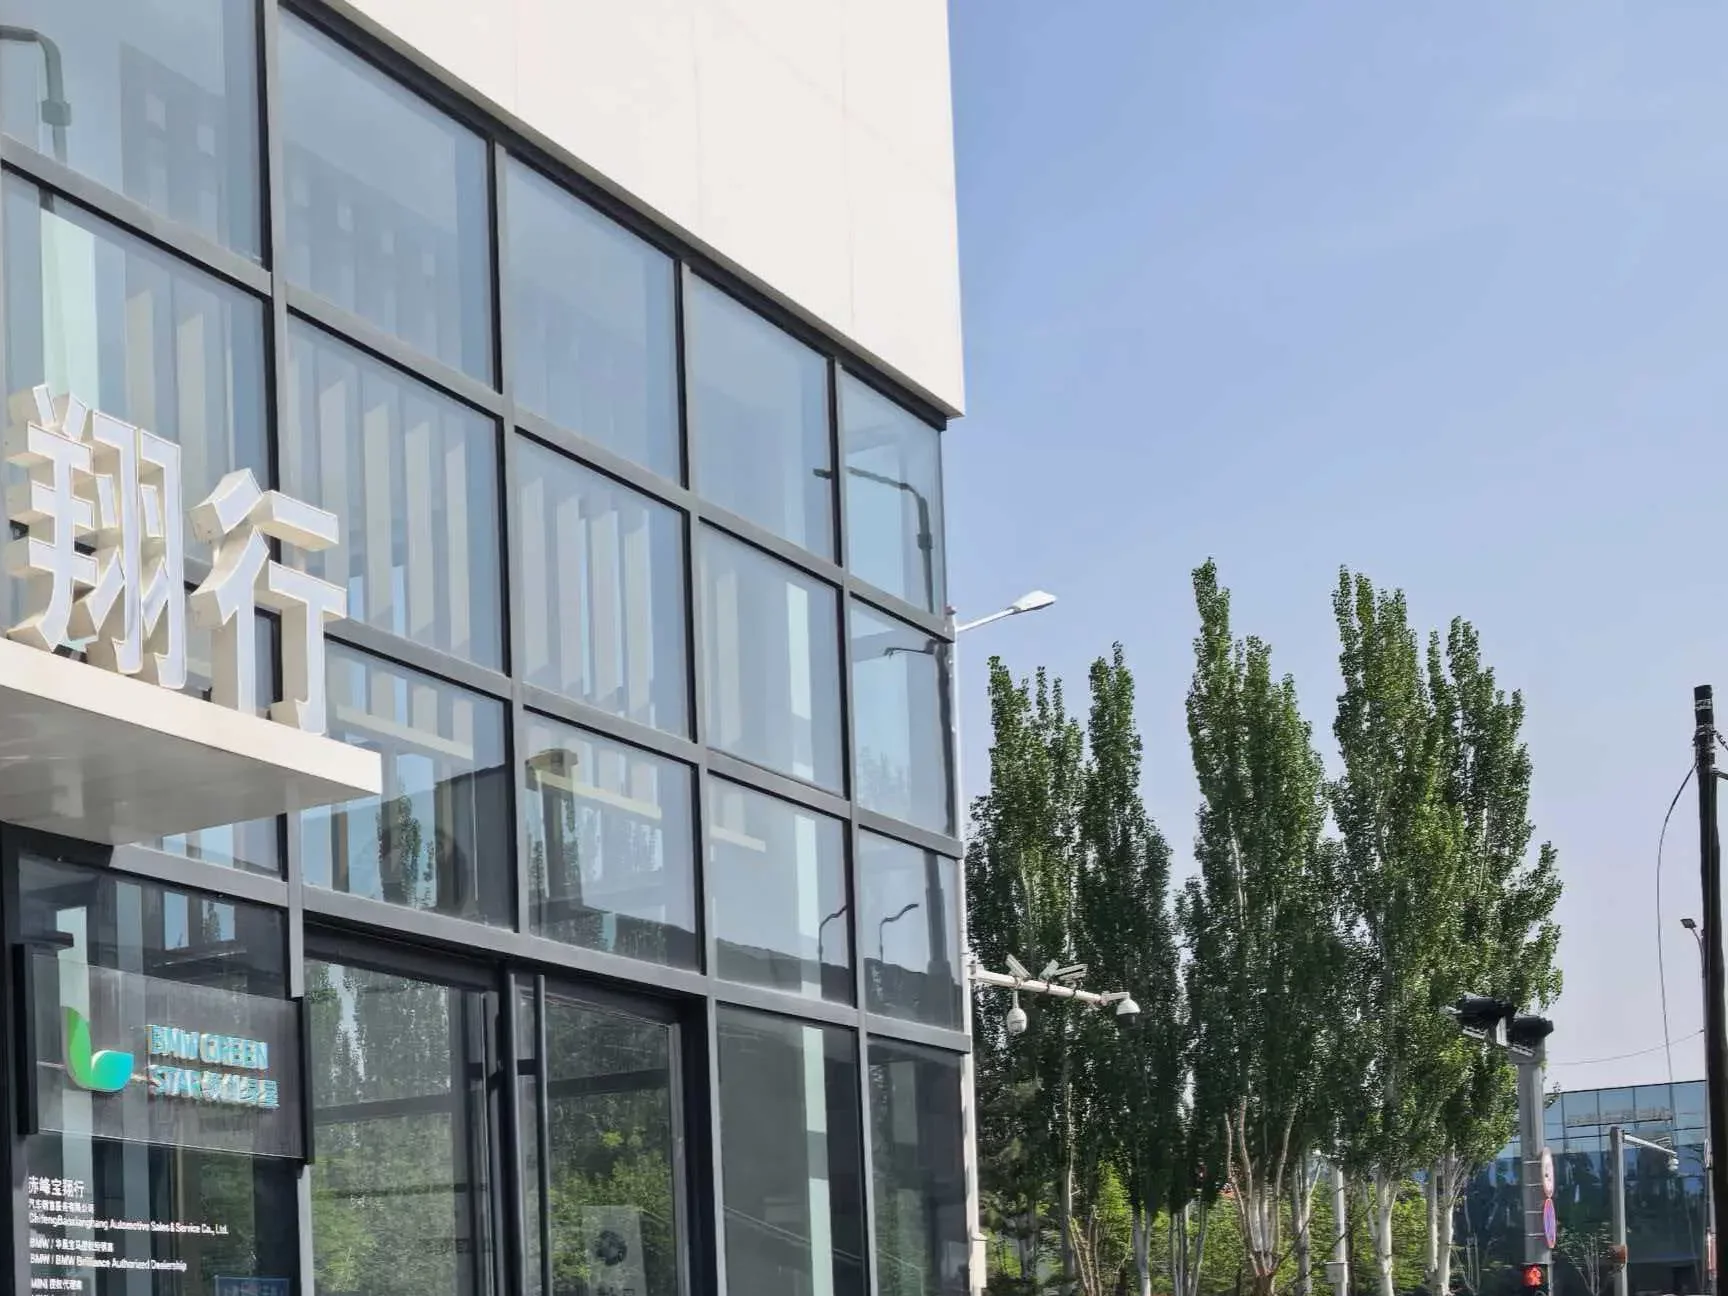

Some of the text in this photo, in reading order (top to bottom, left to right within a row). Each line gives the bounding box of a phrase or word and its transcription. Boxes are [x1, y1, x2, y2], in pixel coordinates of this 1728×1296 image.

[145, 1025, 268, 1070] BMW GREEN
[28, 1176, 84, 1197] 赤峰宝翔行
[30, 1253, 50, 1265] BMW
